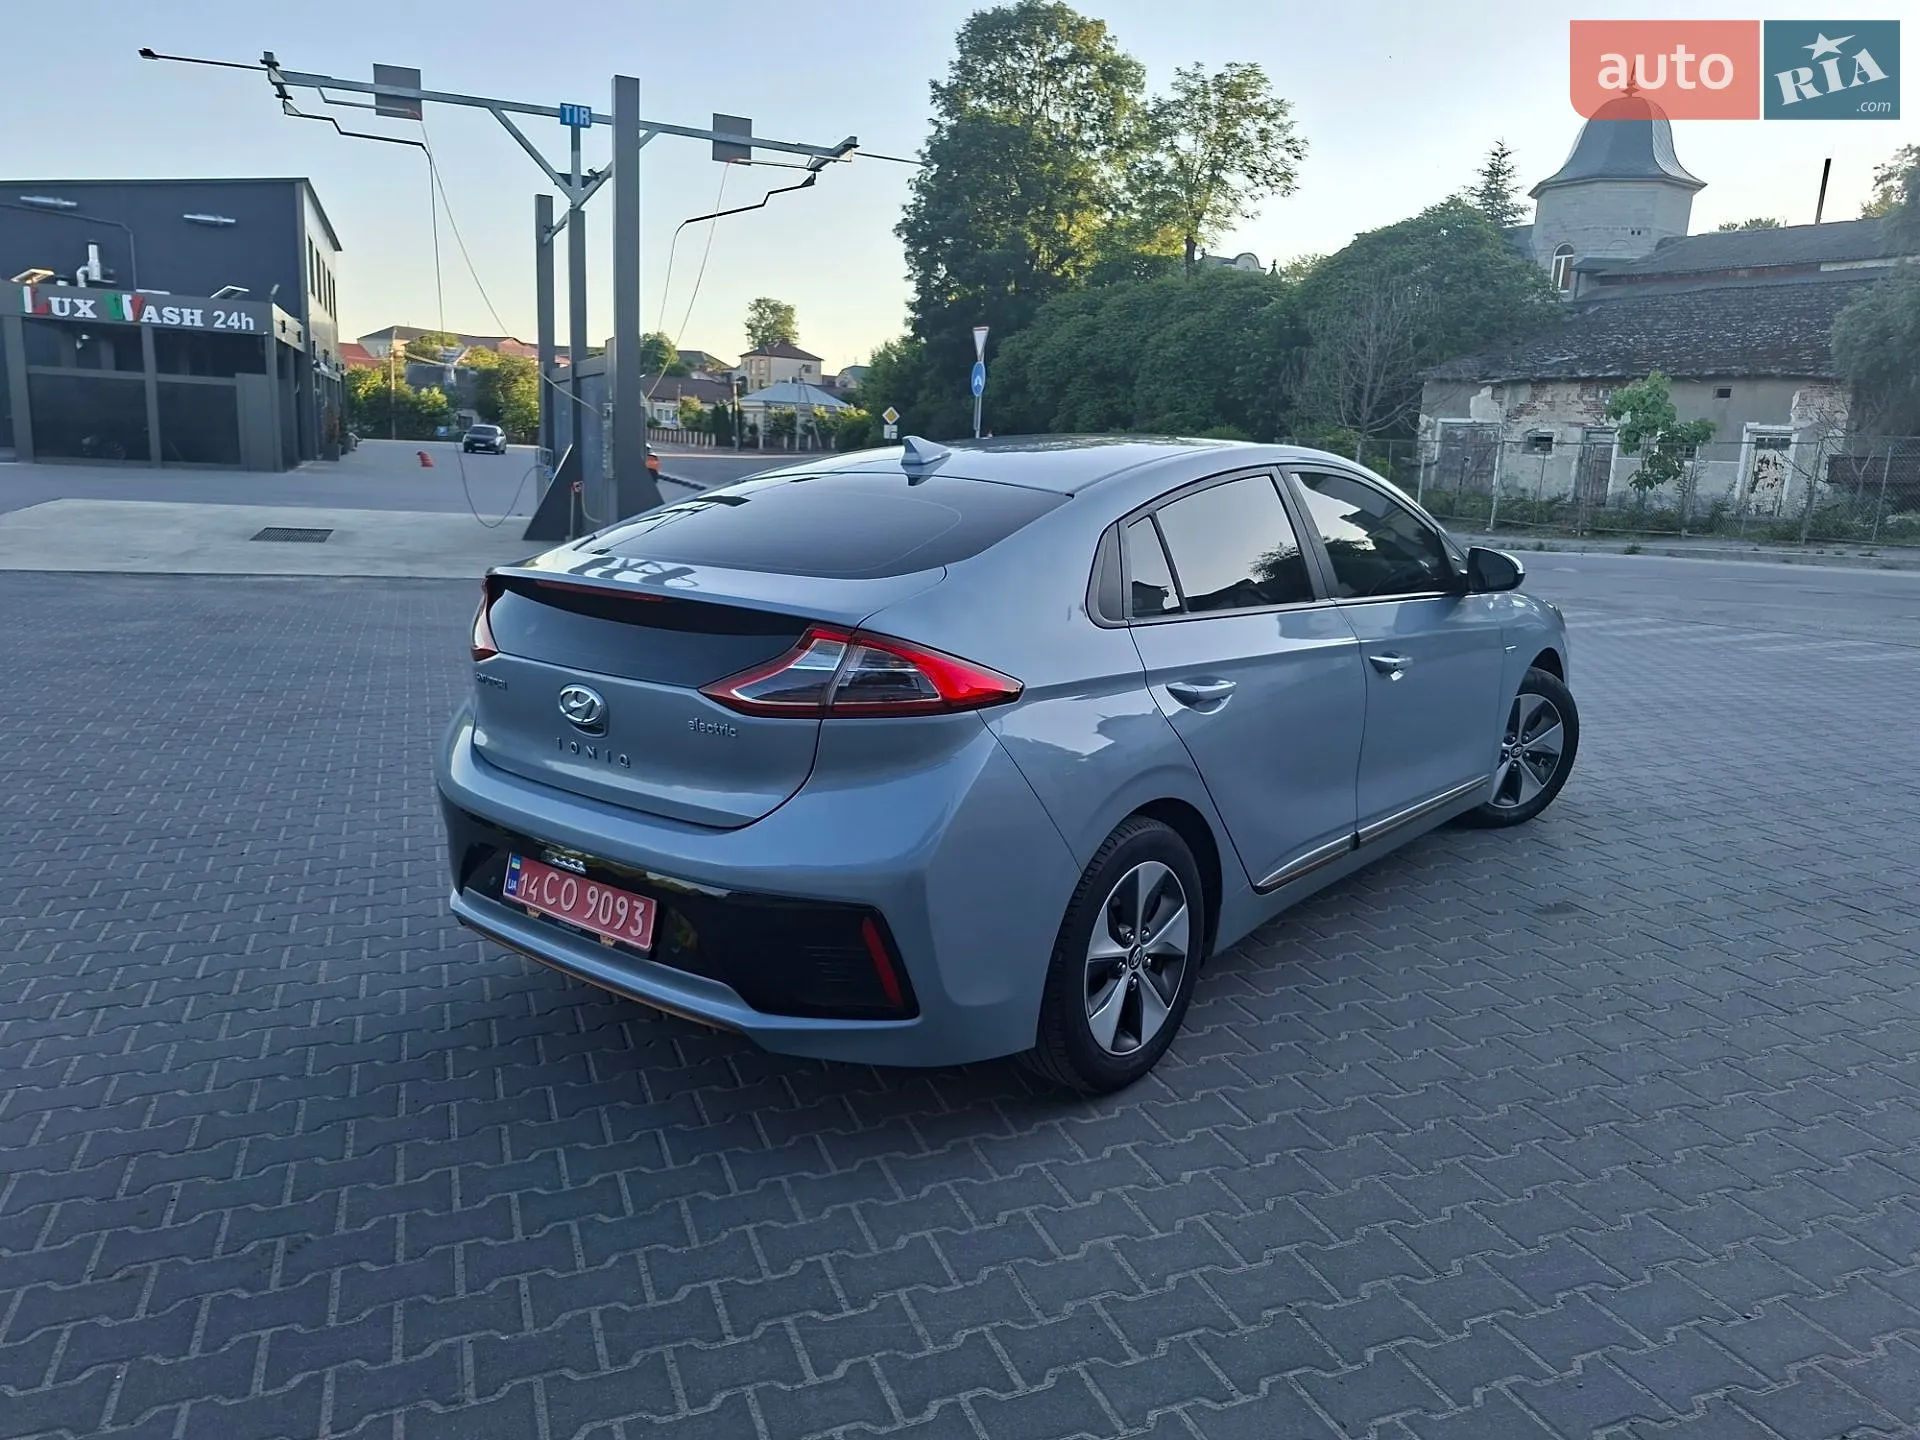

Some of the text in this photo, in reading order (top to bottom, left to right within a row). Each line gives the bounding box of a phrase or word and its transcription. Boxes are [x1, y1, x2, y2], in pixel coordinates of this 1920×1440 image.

[562, 104, 590, 125] TIR
[22, 286, 255, 331] LUX WASH 24h
[688, 717, 738, 738] electric
[556, 736, 631, 768] IONIQ
[585, 885, 646, 937] 9093
